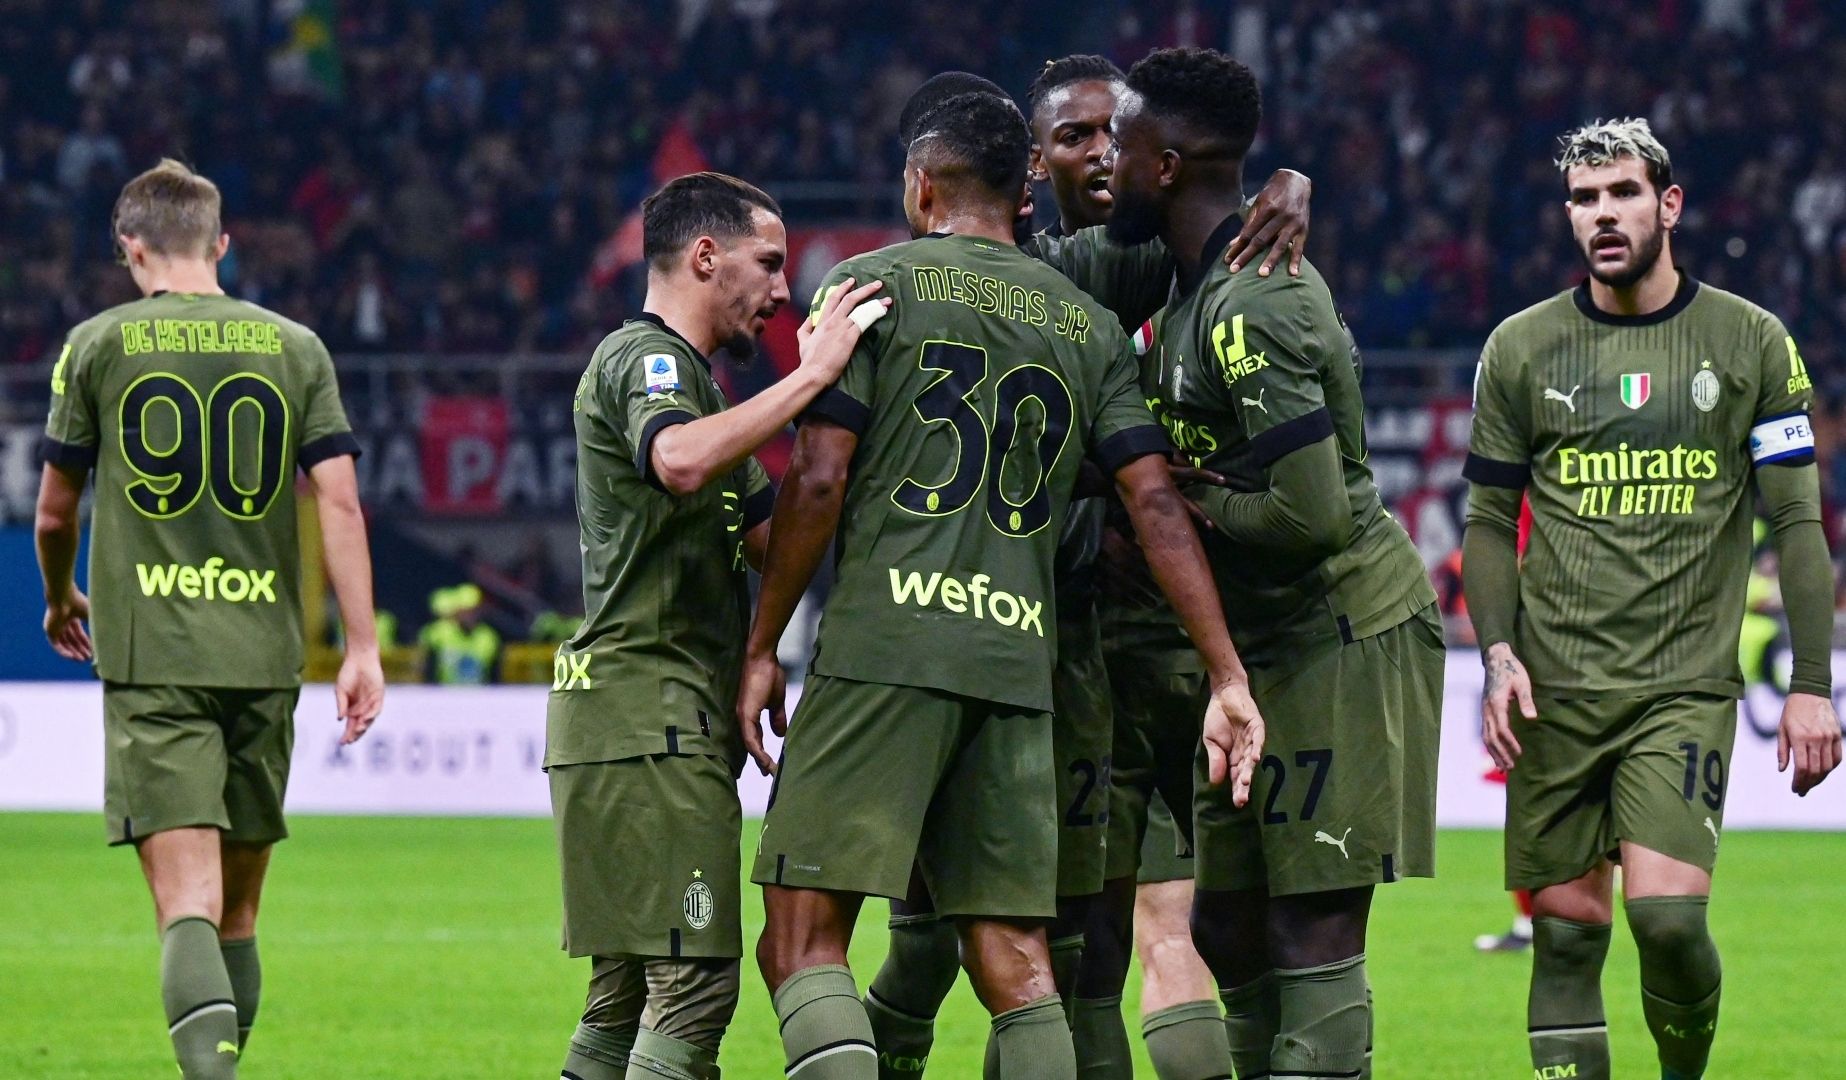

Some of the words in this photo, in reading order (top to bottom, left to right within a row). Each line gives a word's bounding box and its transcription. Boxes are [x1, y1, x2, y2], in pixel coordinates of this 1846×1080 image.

[912, 266, 1048, 326] MESSIAS
[1055, 301, 1090, 343] JR
[121, 320, 154, 355] DE
[154, 319, 282, 355] KETELAERE
[119, 372, 289, 520] 90
[891, 340, 1074, 537] 30
[1559, 443, 1717, 485] Emirates
[1577, 486, 1612, 516] FLY
[1618, 485, 1695, 515] BETTER
[136, 556, 277, 603] wefox
[889, 567, 1044, 638] wefox
[322, 728, 492, 775] ABOUT
[1678, 741, 1724, 811] 19
[1261, 748, 1334, 825] 27
[1534, 1063, 1577, 1080] ACM
